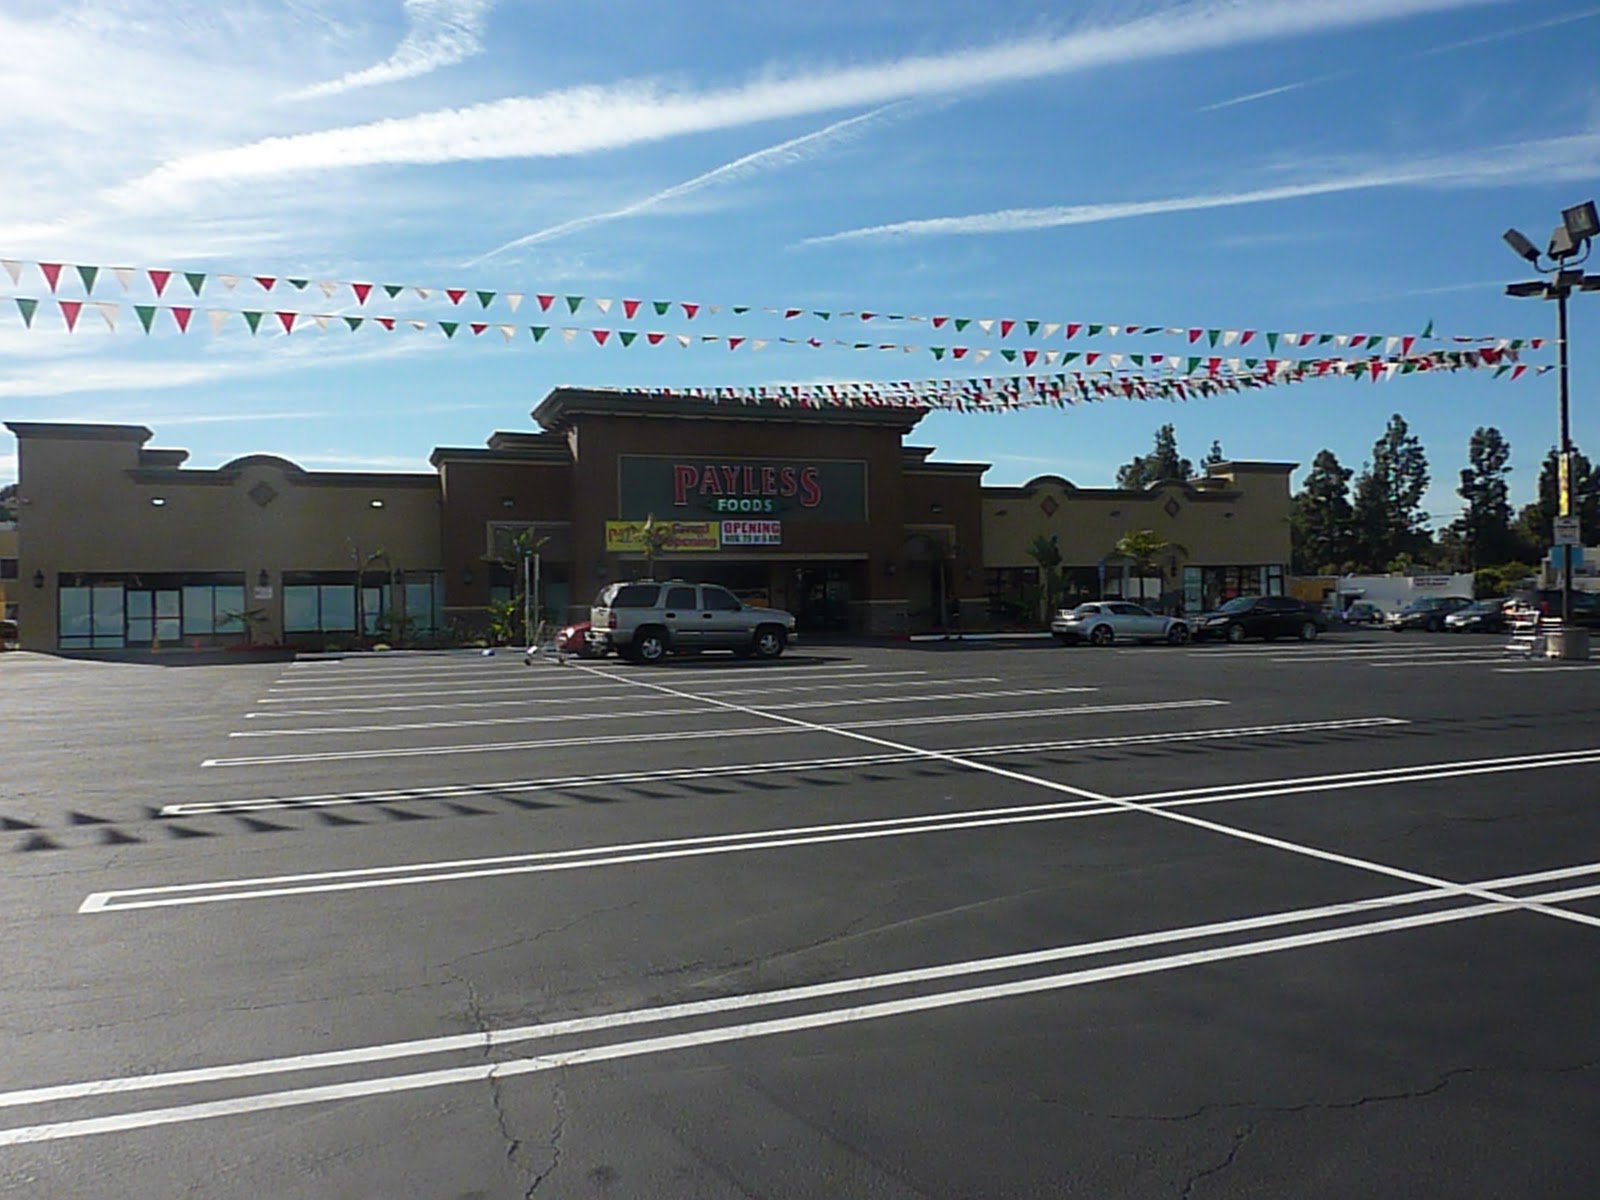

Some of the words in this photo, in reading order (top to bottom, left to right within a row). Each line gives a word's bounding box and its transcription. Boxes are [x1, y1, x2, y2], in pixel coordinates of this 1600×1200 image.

[673, 464, 823, 507] PAYLESS
[717, 499, 773, 512] FOODS
[723, 522, 780, 534] OPENING
